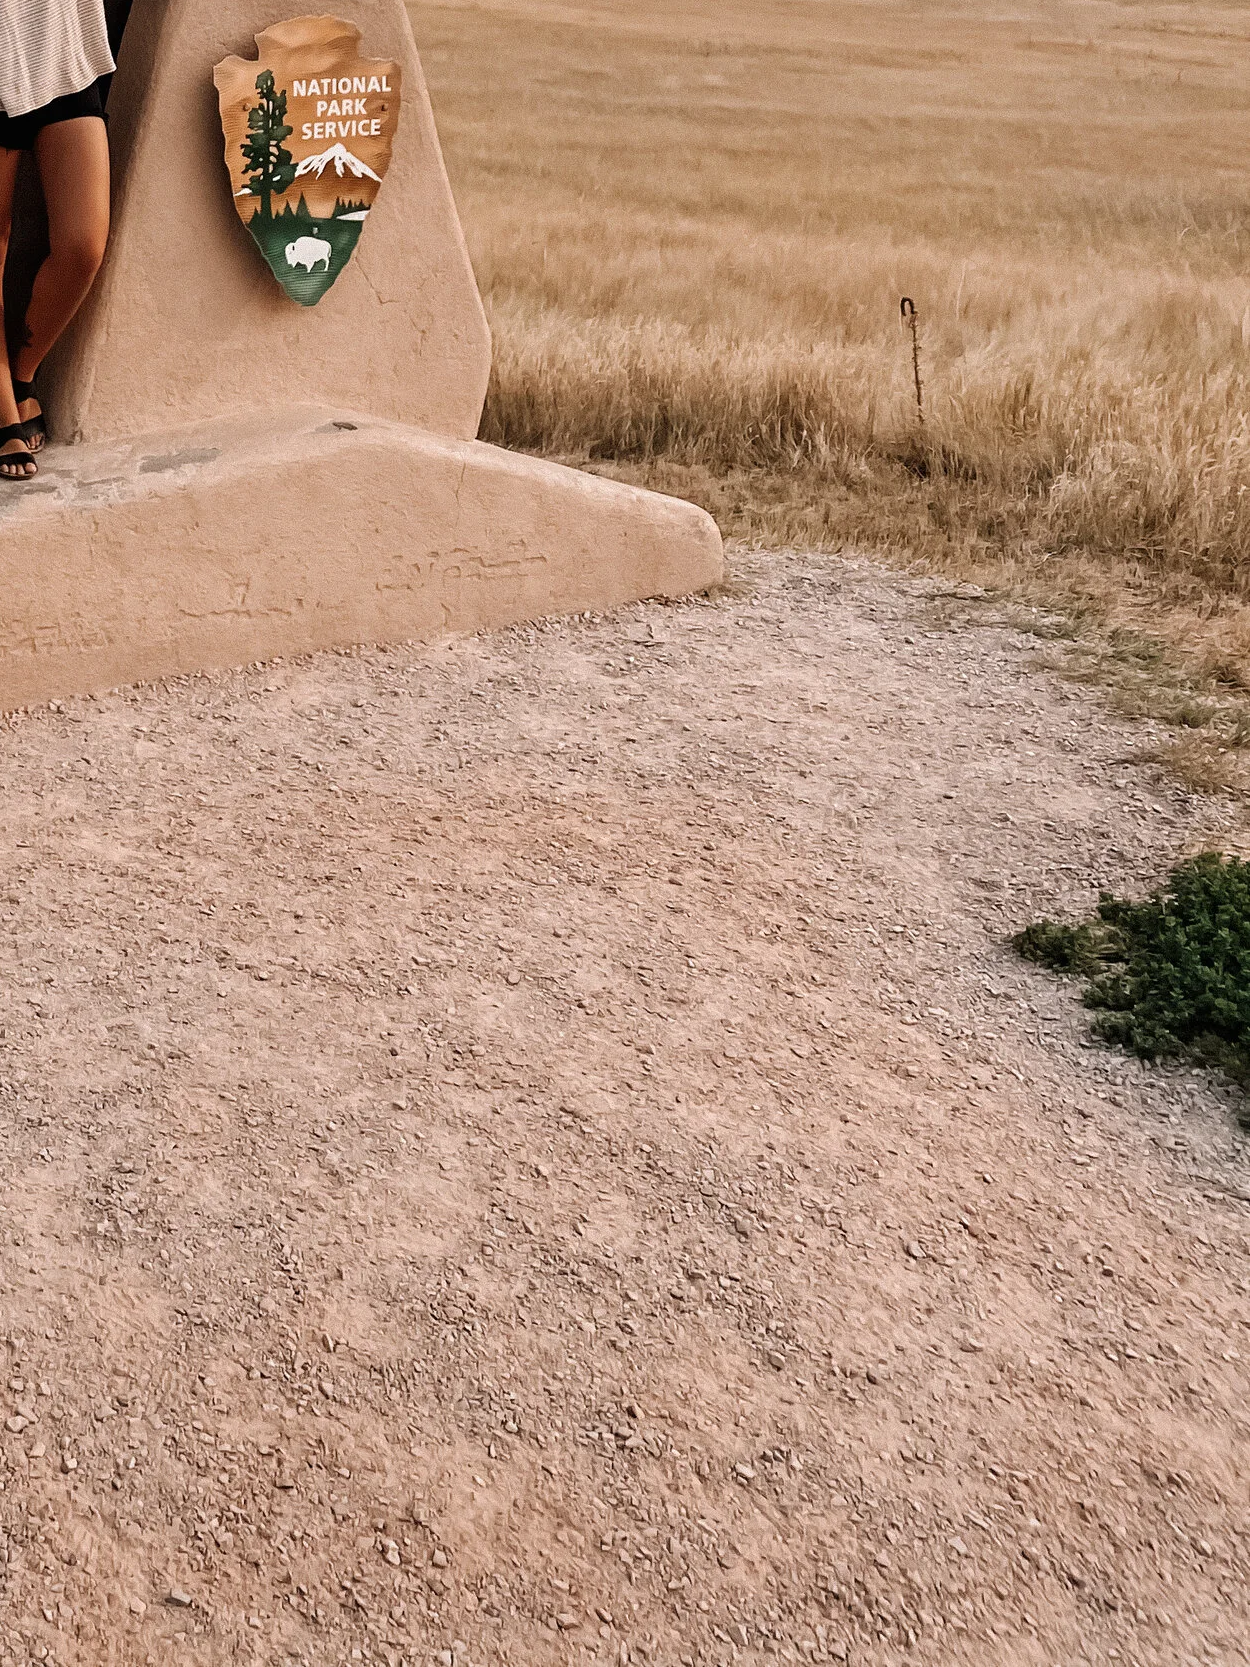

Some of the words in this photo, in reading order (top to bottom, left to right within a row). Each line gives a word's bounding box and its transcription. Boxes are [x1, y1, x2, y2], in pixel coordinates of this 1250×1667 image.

[292, 75, 392, 97] NATIONAL
[316, 98, 367, 118] PARK
[301, 118, 381, 140] SERVICE
